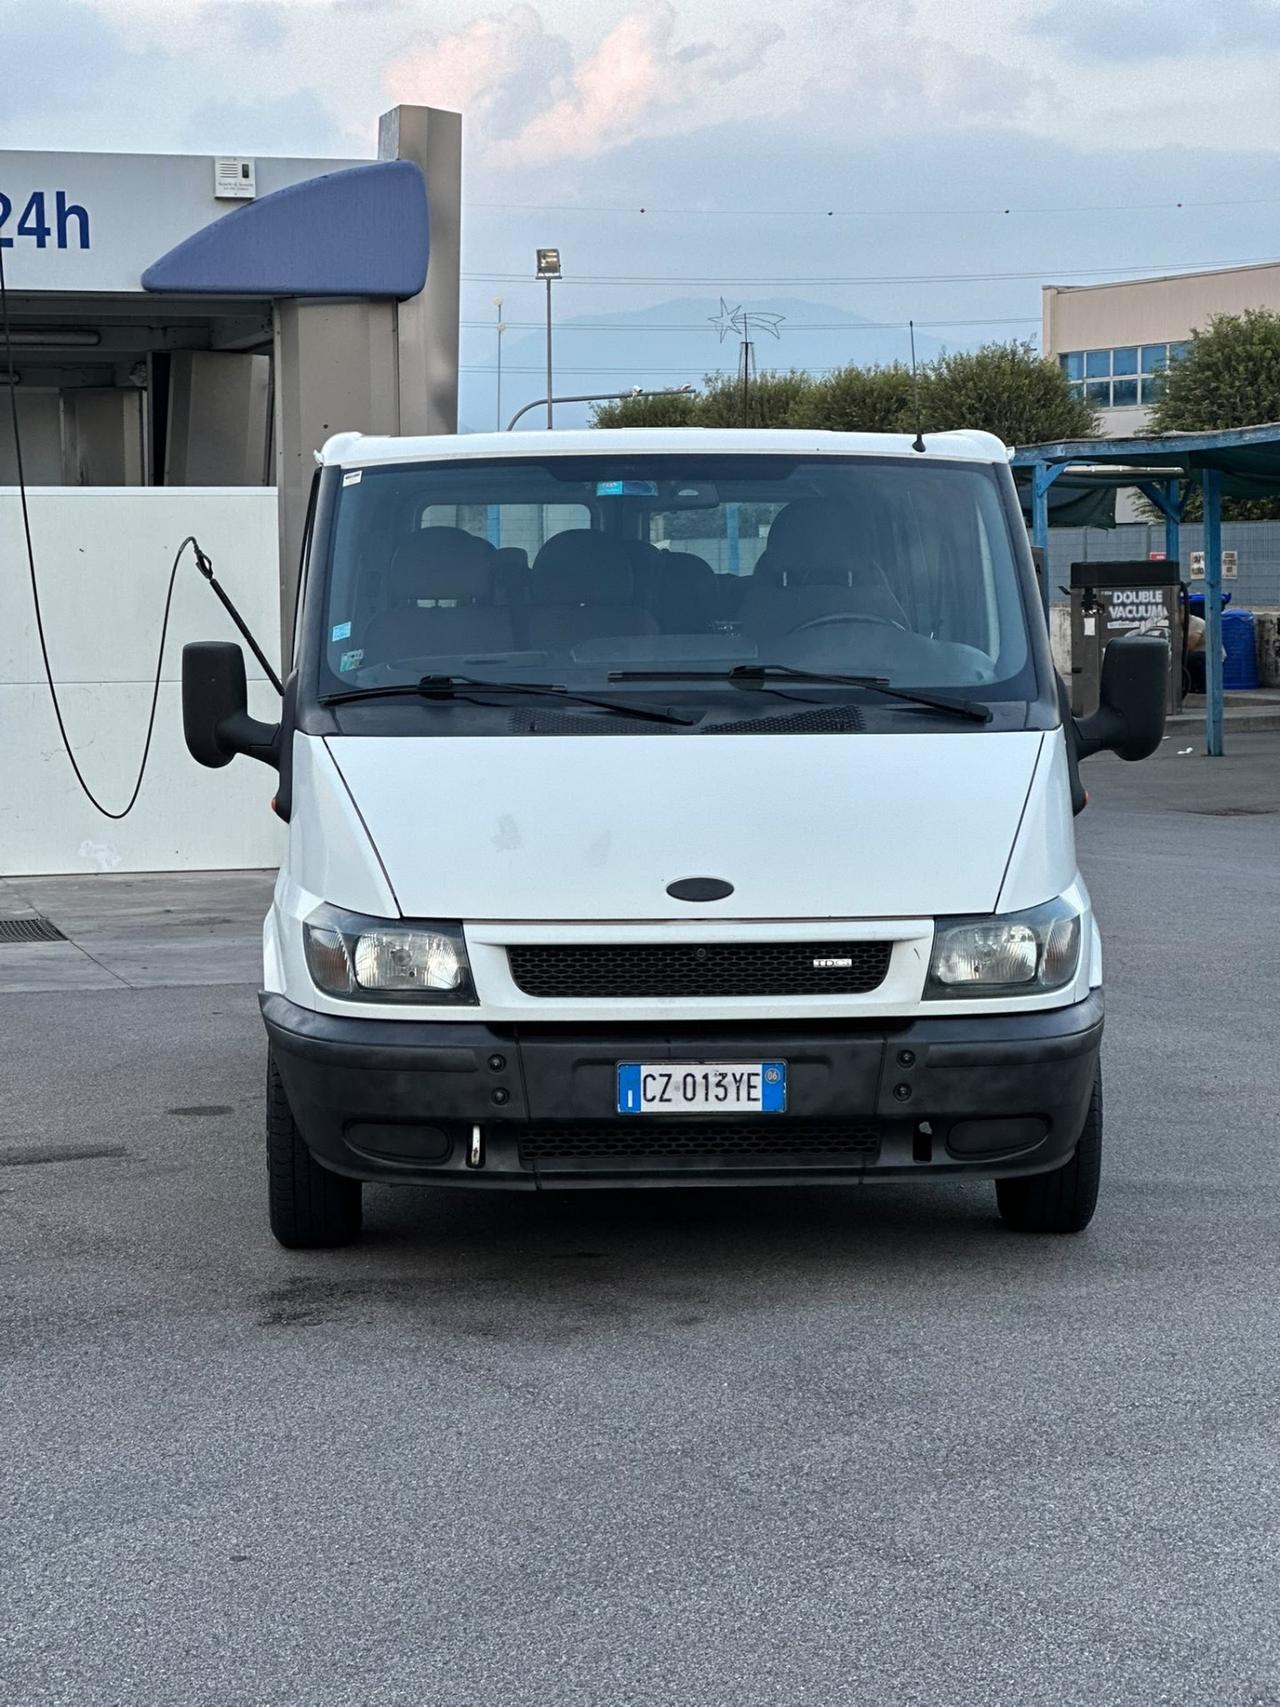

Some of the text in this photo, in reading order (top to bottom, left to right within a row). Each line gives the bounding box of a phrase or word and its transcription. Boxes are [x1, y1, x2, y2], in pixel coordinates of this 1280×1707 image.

[1113, 590, 1163, 604] DOUBLE
[643, 1073, 673, 1103] CZ
[682, 1072, 761, 1103] 013YE
[766, 1070, 778, 1081] 06
